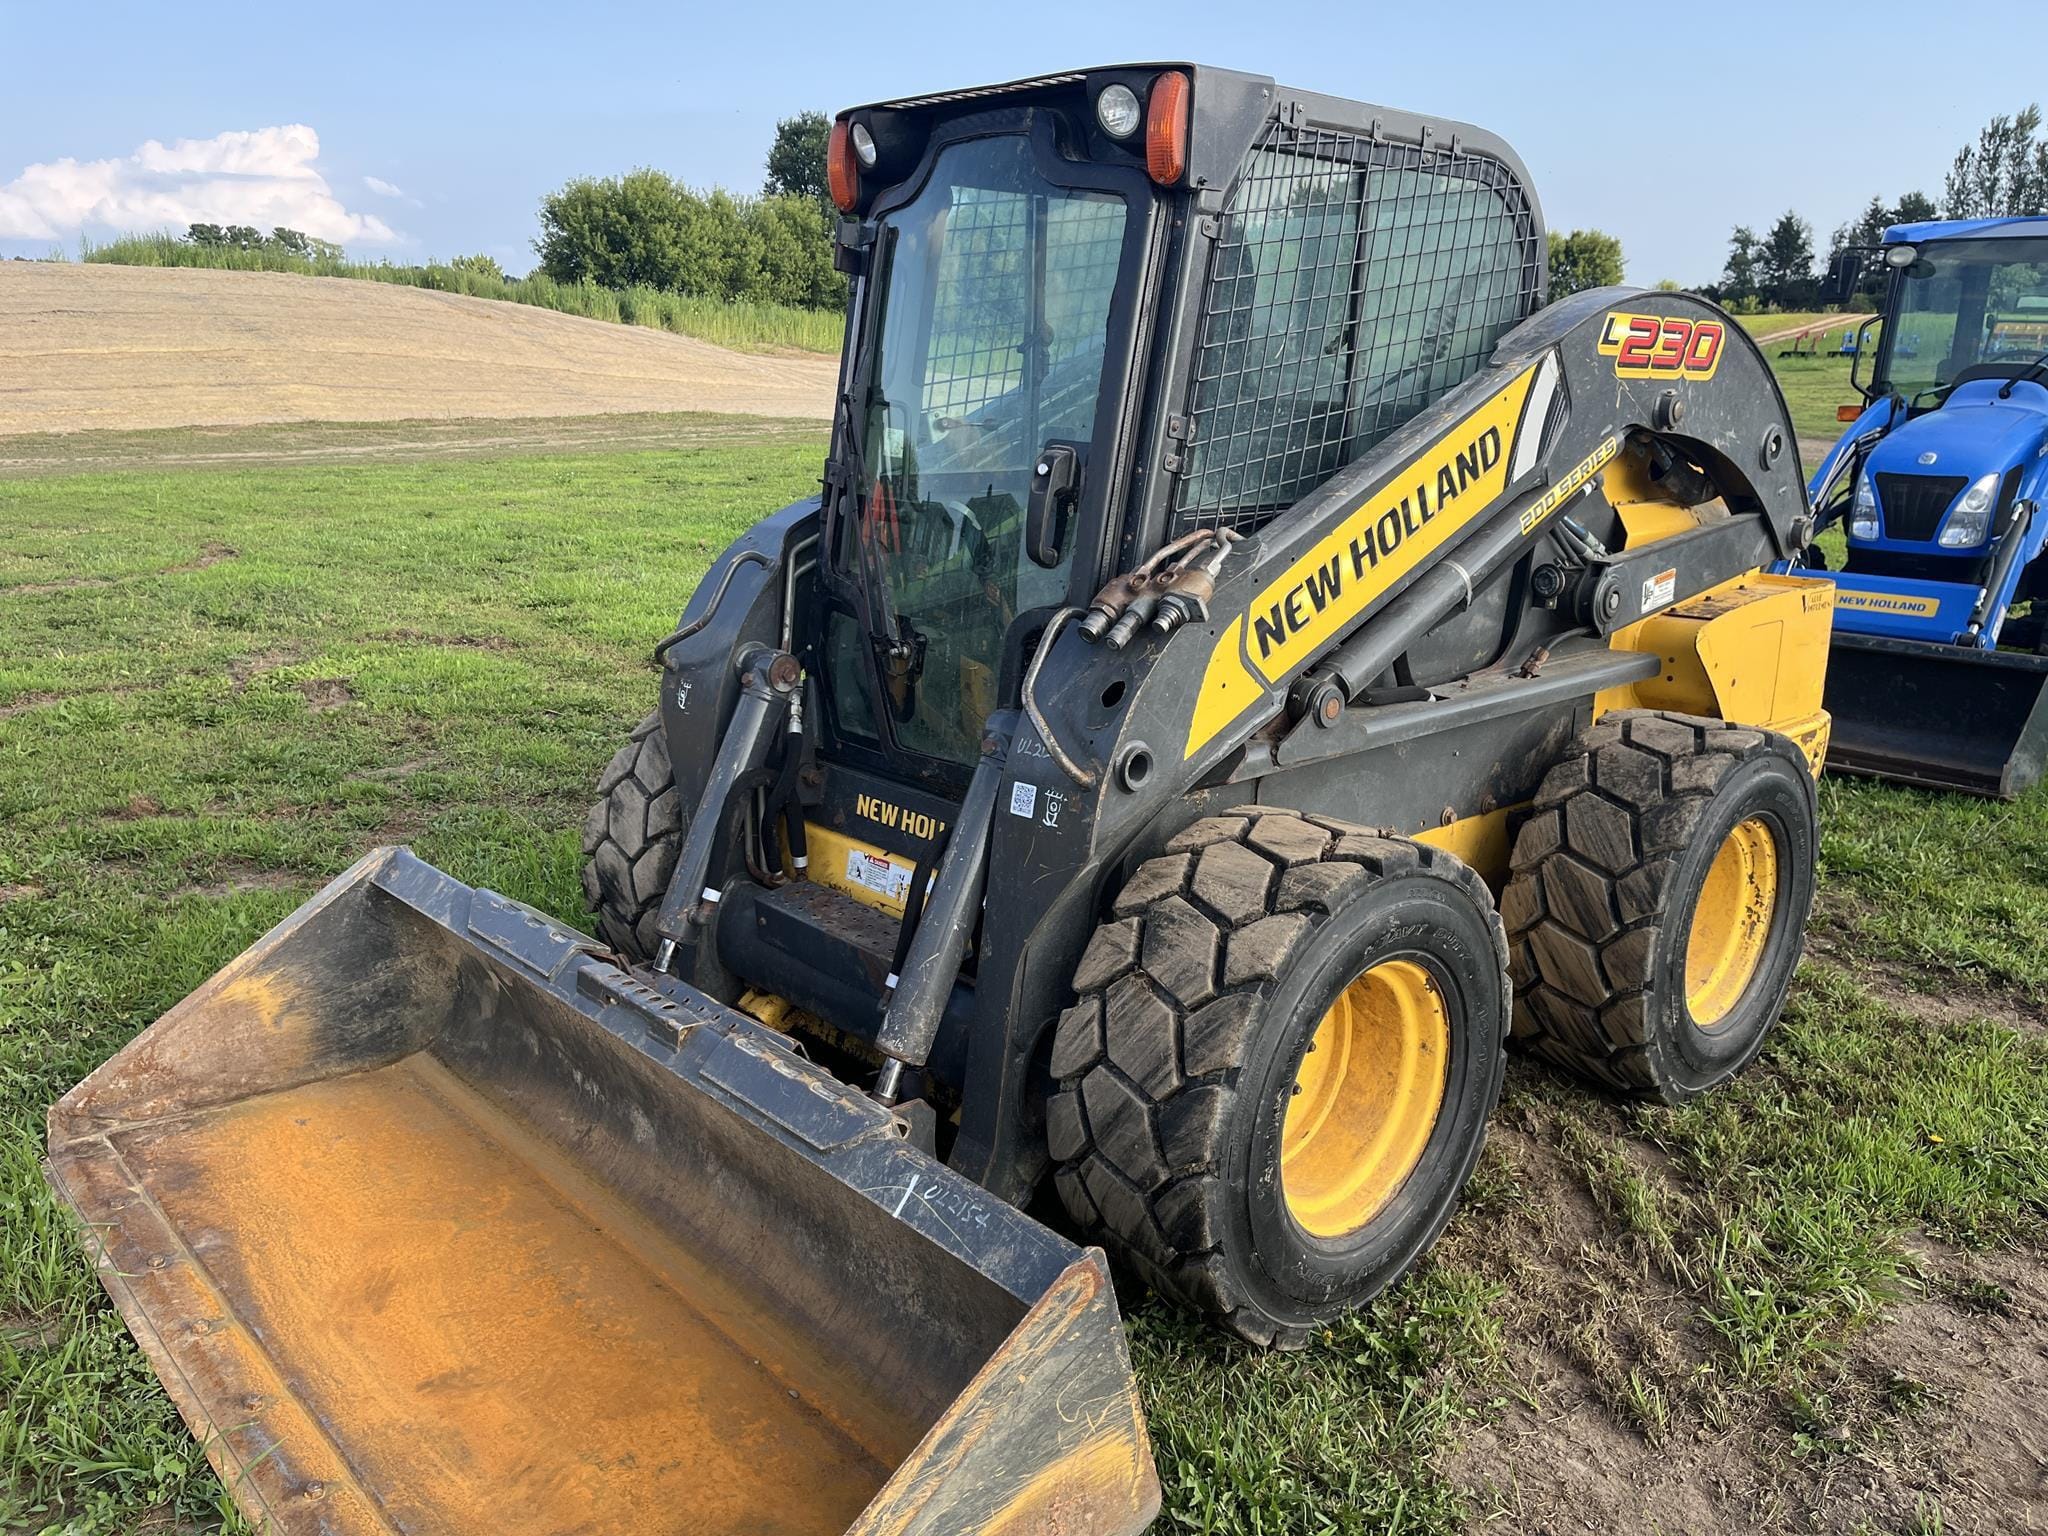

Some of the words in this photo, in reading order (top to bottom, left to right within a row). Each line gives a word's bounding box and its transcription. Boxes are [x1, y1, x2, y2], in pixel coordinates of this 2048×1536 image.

[1601, 316, 1722, 371] L230
[1521, 490, 1556, 531] 200
[1559, 440, 1616, 498] SERIES
[1254, 554, 1341, 661] NEW
[1350, 425, 1501, 582] HOLLAND
[1839, 595, 1867, 606] NEW
[1869, 598, 1926, 612] HOLLAND
[856, 793, 899, 828] NEW
